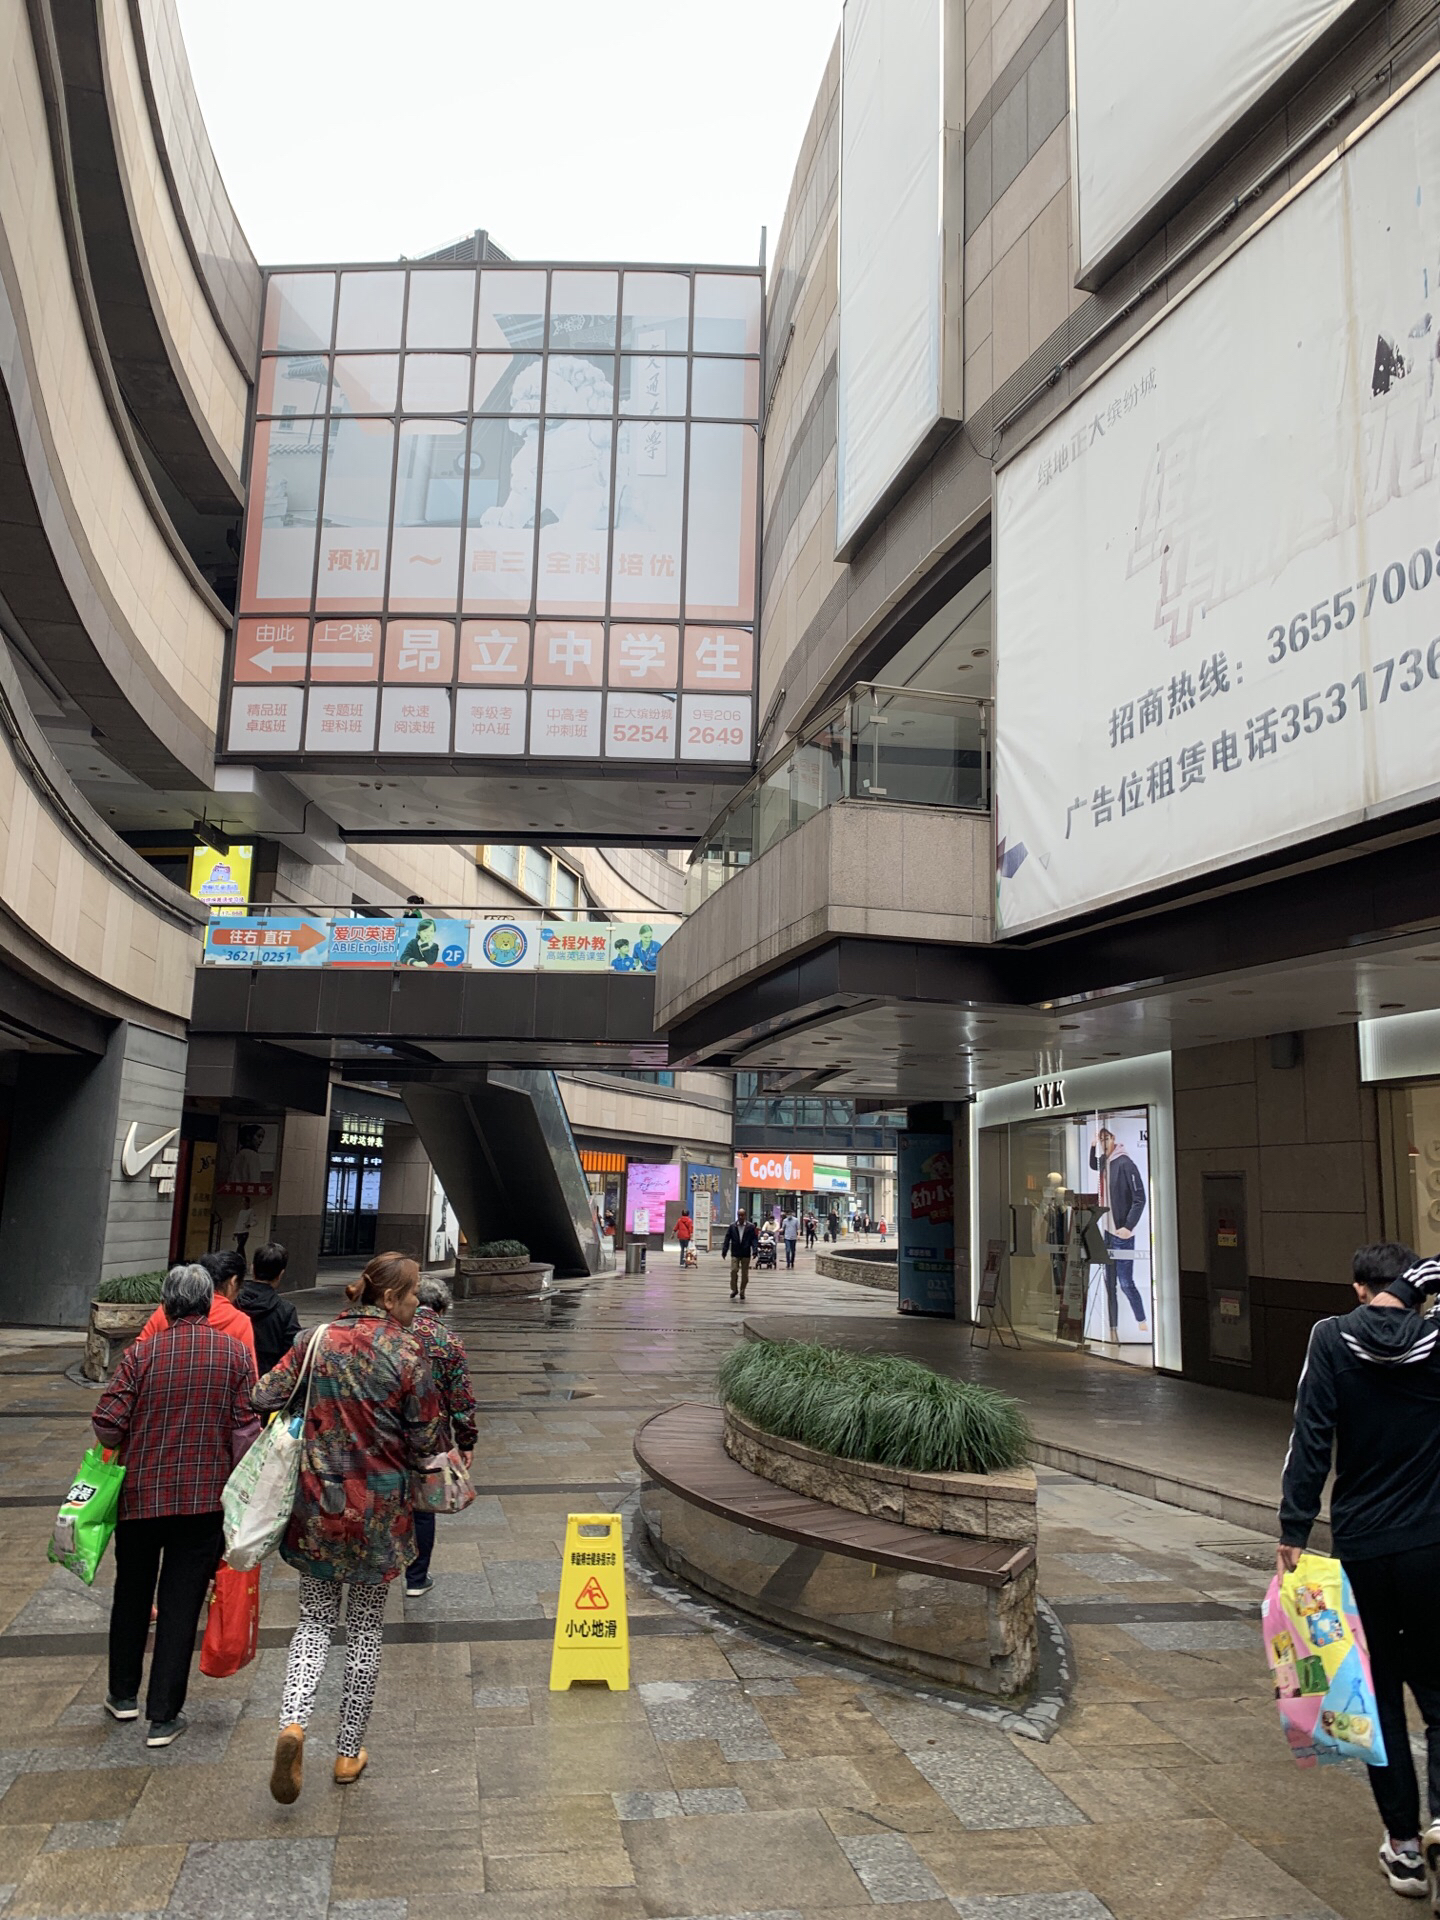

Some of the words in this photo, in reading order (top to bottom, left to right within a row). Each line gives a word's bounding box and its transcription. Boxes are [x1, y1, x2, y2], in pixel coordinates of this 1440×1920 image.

[1037, 366, 1157, 490] 绿地正大缤纷城
[1267, 538, 1440, 665] 3655700
[256, 624, 295, 643] 由此
[318, 623, 374, 643] 上2楼
[398, 629, 741, 679] 昂立中学生
[247, 703, 288, 717] 精品班
[323, 703, 363, 717] 专题班
[402, 705, 430, 718] 快速
[471, 706, 513, 720] 等级考
[547, 708, 589, 722] 中高考
[613, 707, 673, 720] 正大缤纷城
[692, 709, 741, 722] 9号206
[246, 719, 287, 733] 卓越班
[321, 719, 362, 733] 理科班
[394, 721, 436, 734] 阅读班
[472, 722, 511, 736] 冲A班
[546, 724, 588, 738] 冲刺班
[613, 724, 669, 743] 5254
[688, 726, 744, 745] 2649
[230, 930, 258, 944] 往右
[263, 930, 291, 945] 直行
[333, 926, 396, 941] 爱贝英语
[358, 943, 395, 956] English
[547, 936, 607, 951] 全程外教
[225, 950, 255, 962] 3621
[262, 951, 292, 963] 0251
[445, 950, 462, 962] 2F
[547, 951, 606, 961] 高端英语课堂
[1033, 1080, 1065, 1111] KYK
[750, 1157, 782, 1180] CoCo
[565, 1619, 617, 1639] 小心地滑
